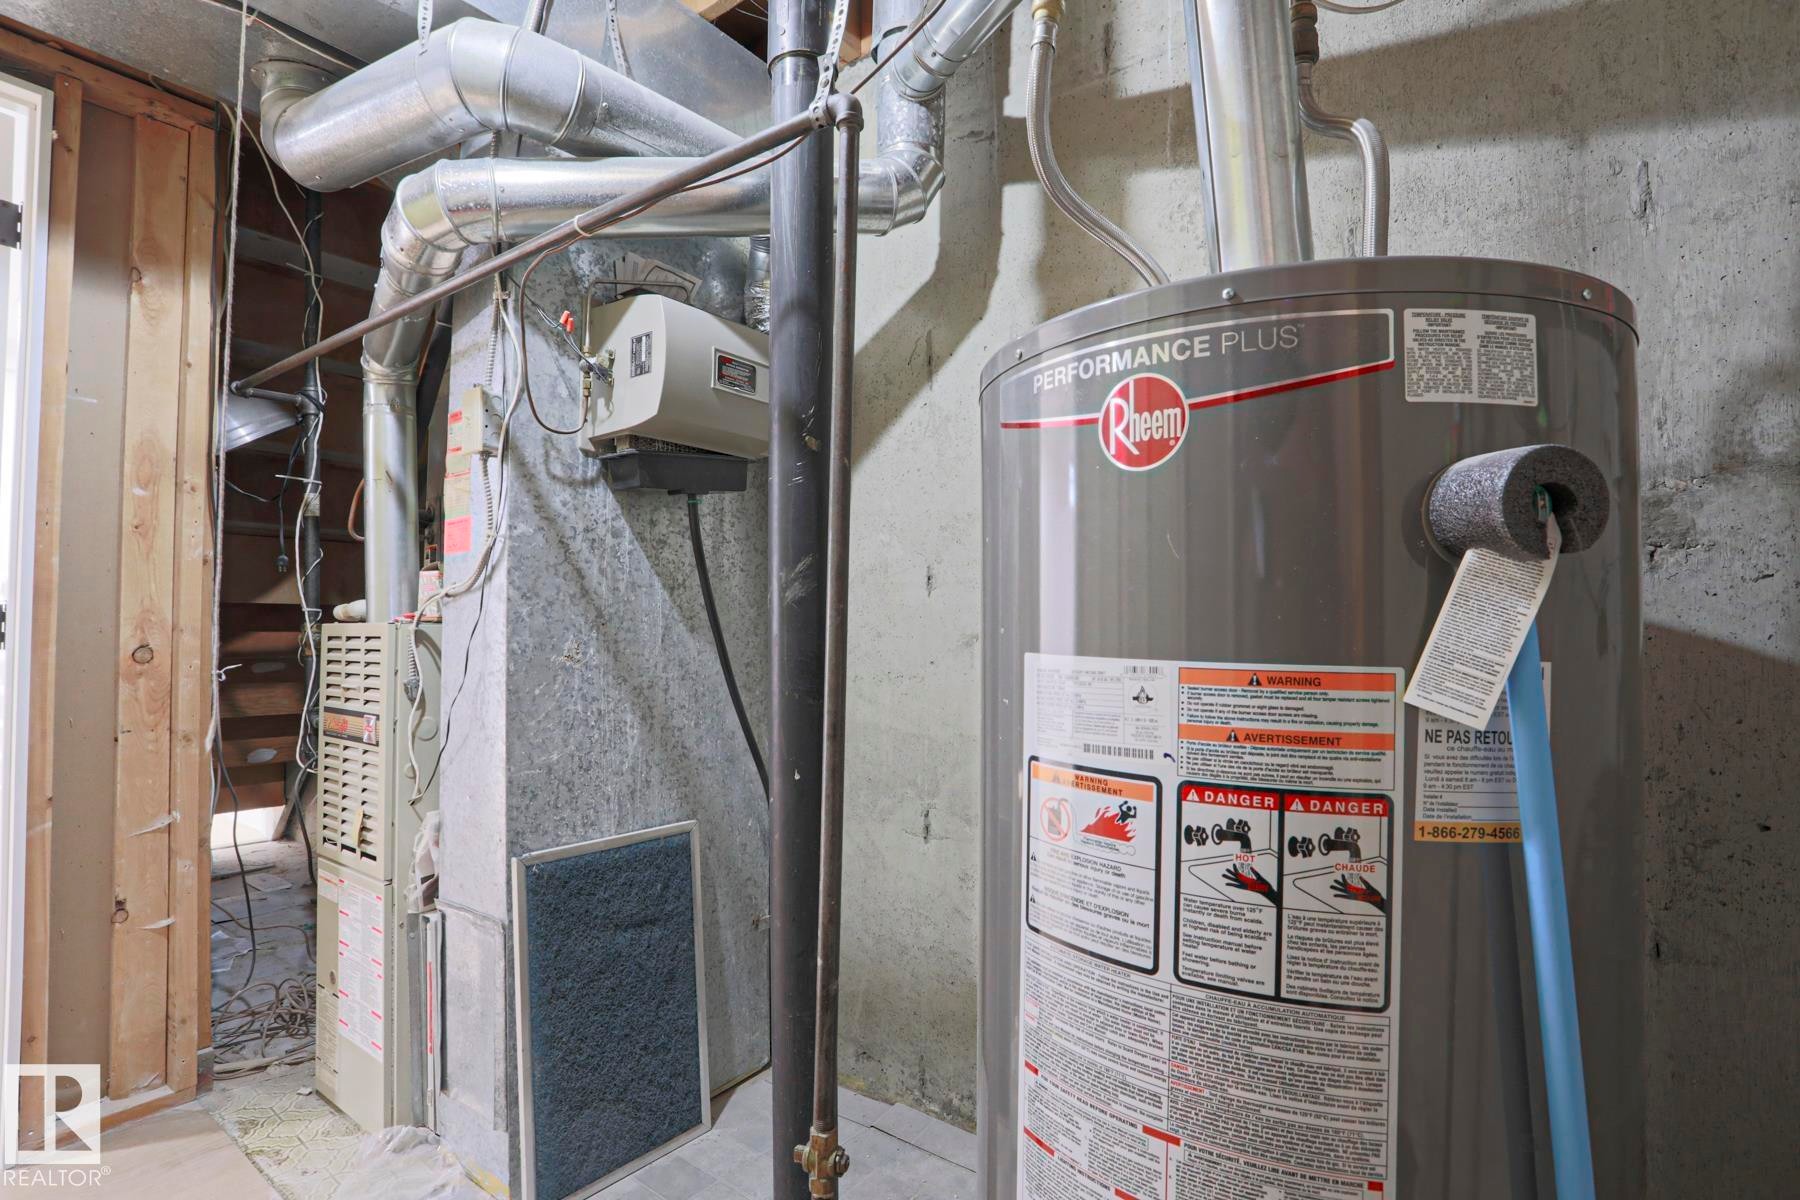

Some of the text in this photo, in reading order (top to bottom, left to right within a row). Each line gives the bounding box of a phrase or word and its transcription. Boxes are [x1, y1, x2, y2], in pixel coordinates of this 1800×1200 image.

[1032, 335, 1210, 395] PERFORMANCE
[1109, 379, 1182, 456] Rheem
[1267, 676, 1321, 687] WARNING
[1244, 733, 1342, 746] AVERTISSEMENT
[1425, 729, 1442, 743] NE
[1447, 729, 1471, 744] PAS
[1074, 774, 1108, 787] WARNING
[1204, 791, 1275, 808] DANGER
[1310, 800, 1384, 814] DANGER
[1419, 825, 1520, 840] 1-866-279-4566
[1235, 854, 1256, 862] HOT
[1335, 863, 1376, 873] CHAUDE
[1253, 1004, 1300, 1016] ACCUMULATION
[1302, 1011, 1346, 1021] AUTOMATIQUE
